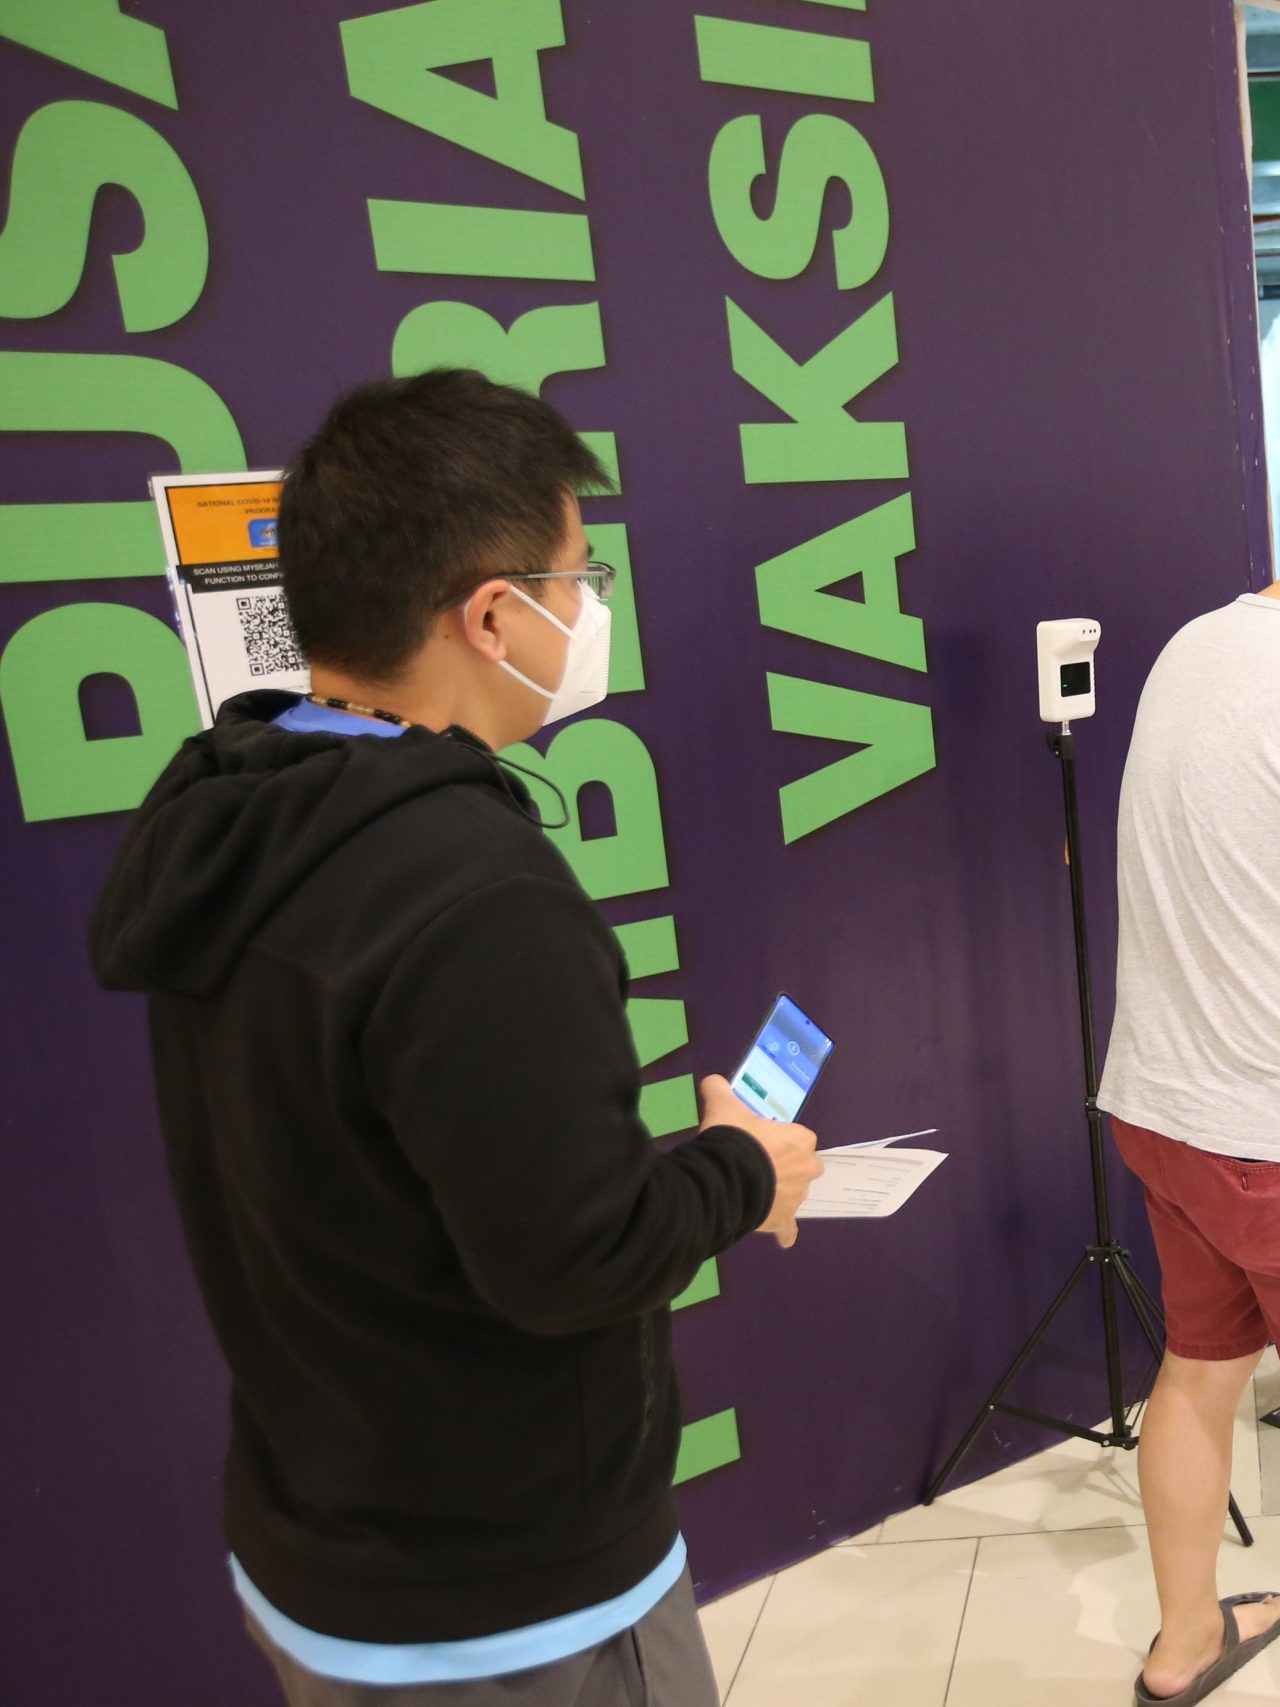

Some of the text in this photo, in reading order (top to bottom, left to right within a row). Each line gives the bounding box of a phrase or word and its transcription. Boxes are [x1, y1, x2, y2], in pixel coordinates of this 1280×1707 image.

[693, 0, 937, 846] VAKSI
[193, 566, 217, 576] SCAN
[217, 565, 242, 574] USING
[204, 574, 245, 585] FUNCTION
[247, 574, 257, 582] TO
